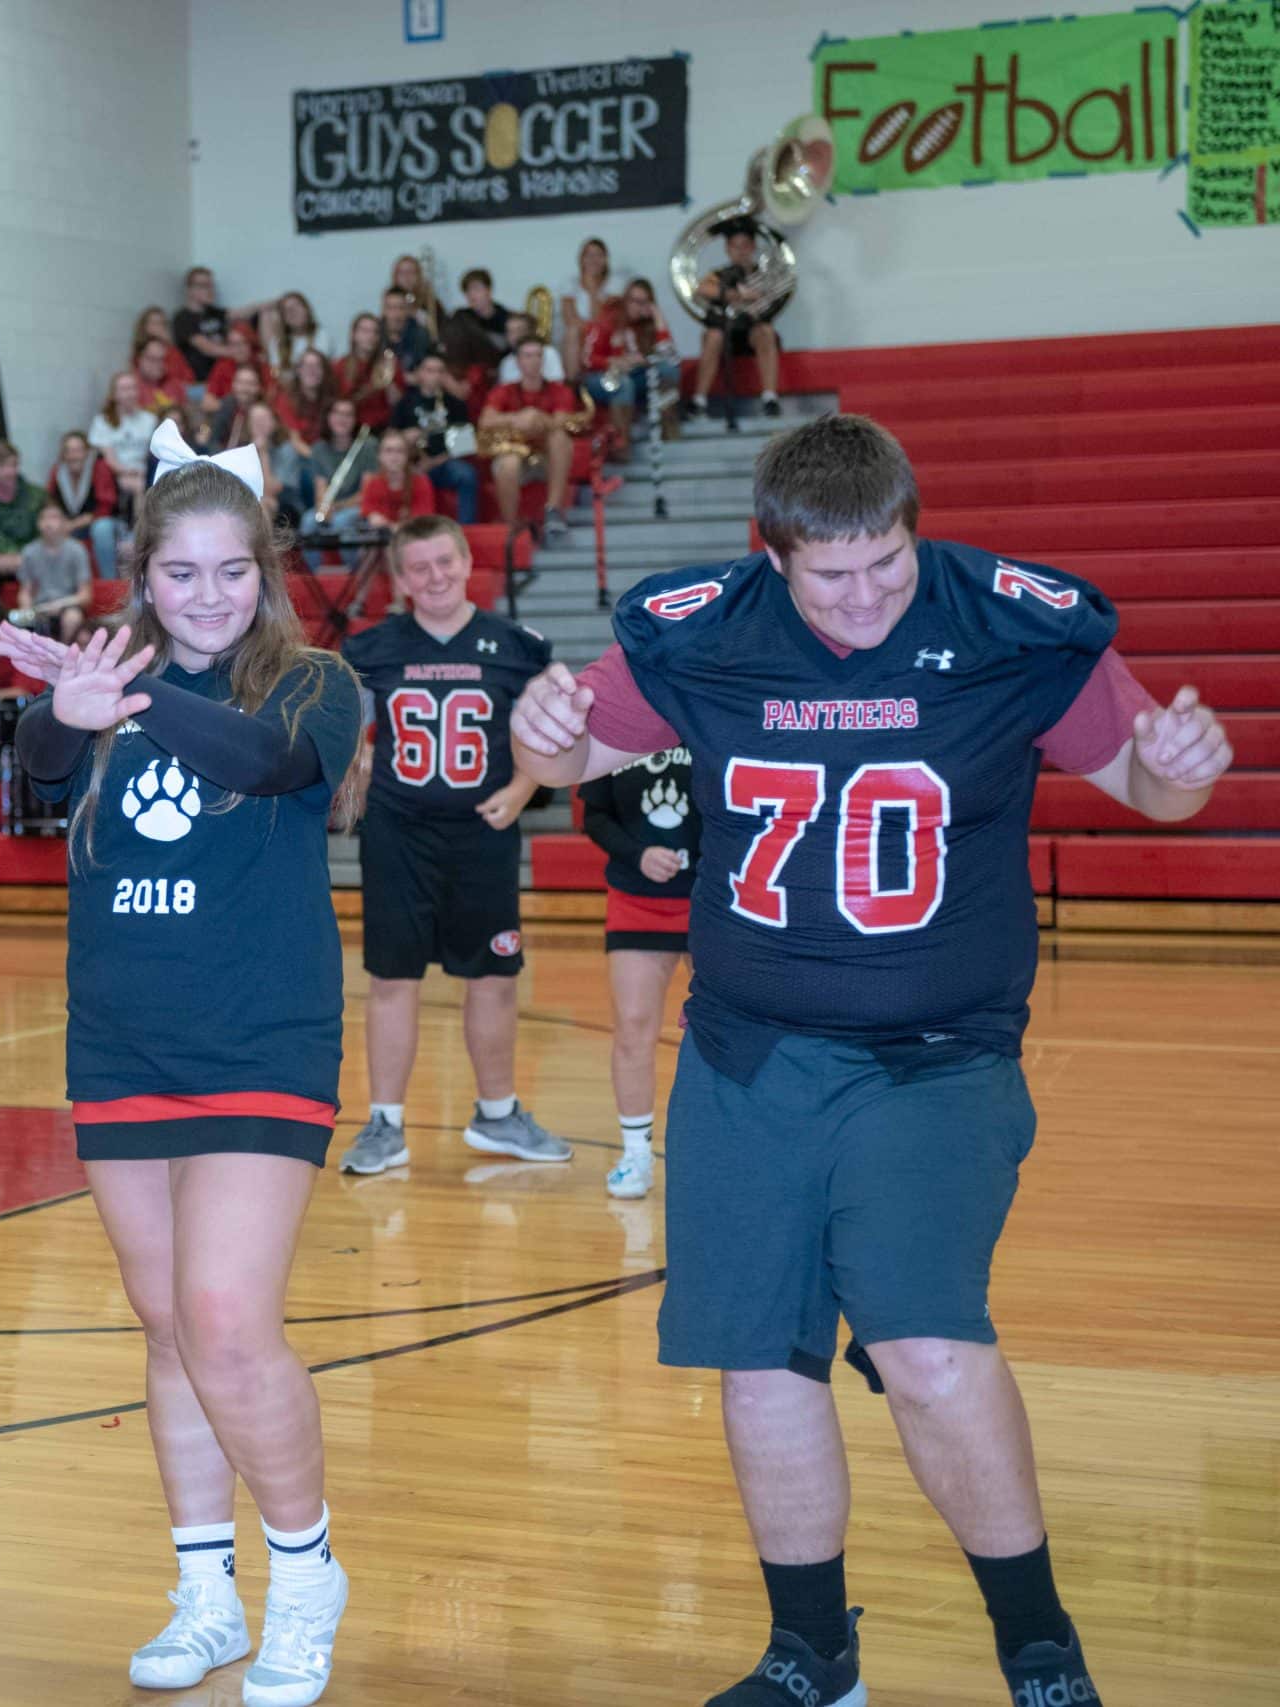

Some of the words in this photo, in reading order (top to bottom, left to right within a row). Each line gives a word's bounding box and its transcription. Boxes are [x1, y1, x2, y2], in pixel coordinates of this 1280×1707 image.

[299, 109, 440, 189] GUYS
[449, 93, 660, 176] SOCCER
[643, 580, 724, 621] 0
[992, 560, 1080, 610] 7
[386, 687, 494, 790] 66
[763, 698, 919, 730] PANTHERS
[723, 756, 952, 936] 70
[112, 877, 197, 915] 2018
[756, 1652, 821, 1707] idas
[1015, 1672, 1098, 1707] didas
